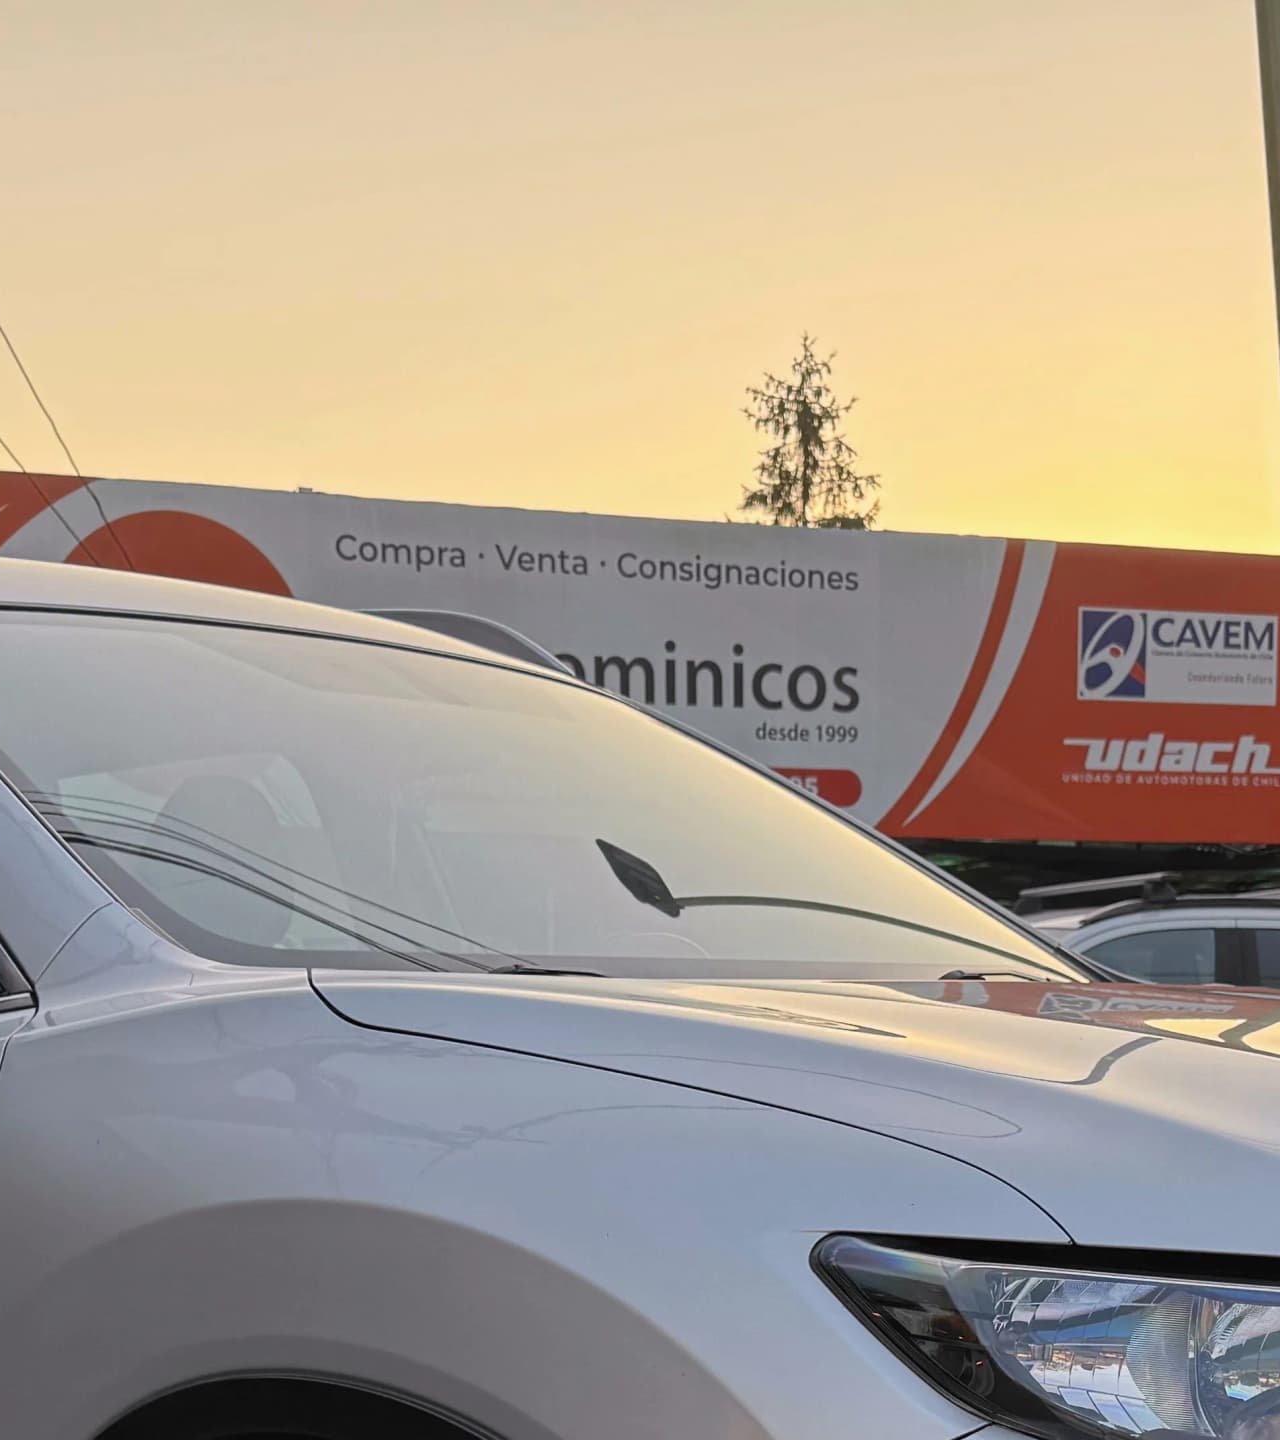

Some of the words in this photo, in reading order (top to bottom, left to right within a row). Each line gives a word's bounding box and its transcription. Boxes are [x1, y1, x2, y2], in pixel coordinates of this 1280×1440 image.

[335, 534, 467, 572] Compra
[495, 543, 589, 576] Venta
[617, 552, 859, 591] Consignaciones
[1151, 617, 1274, 652] CAVEM
[755, 722, 810, 743] desde
[816, 724, 859, 744] 1999
[1062, 773, 1111, 785] UNIDAD
[1116, 774, 1132, 785] DE
[1136, 774, 1228, 787] AUTOMOTORAS
[1232, 775, 1249, 787] DE
